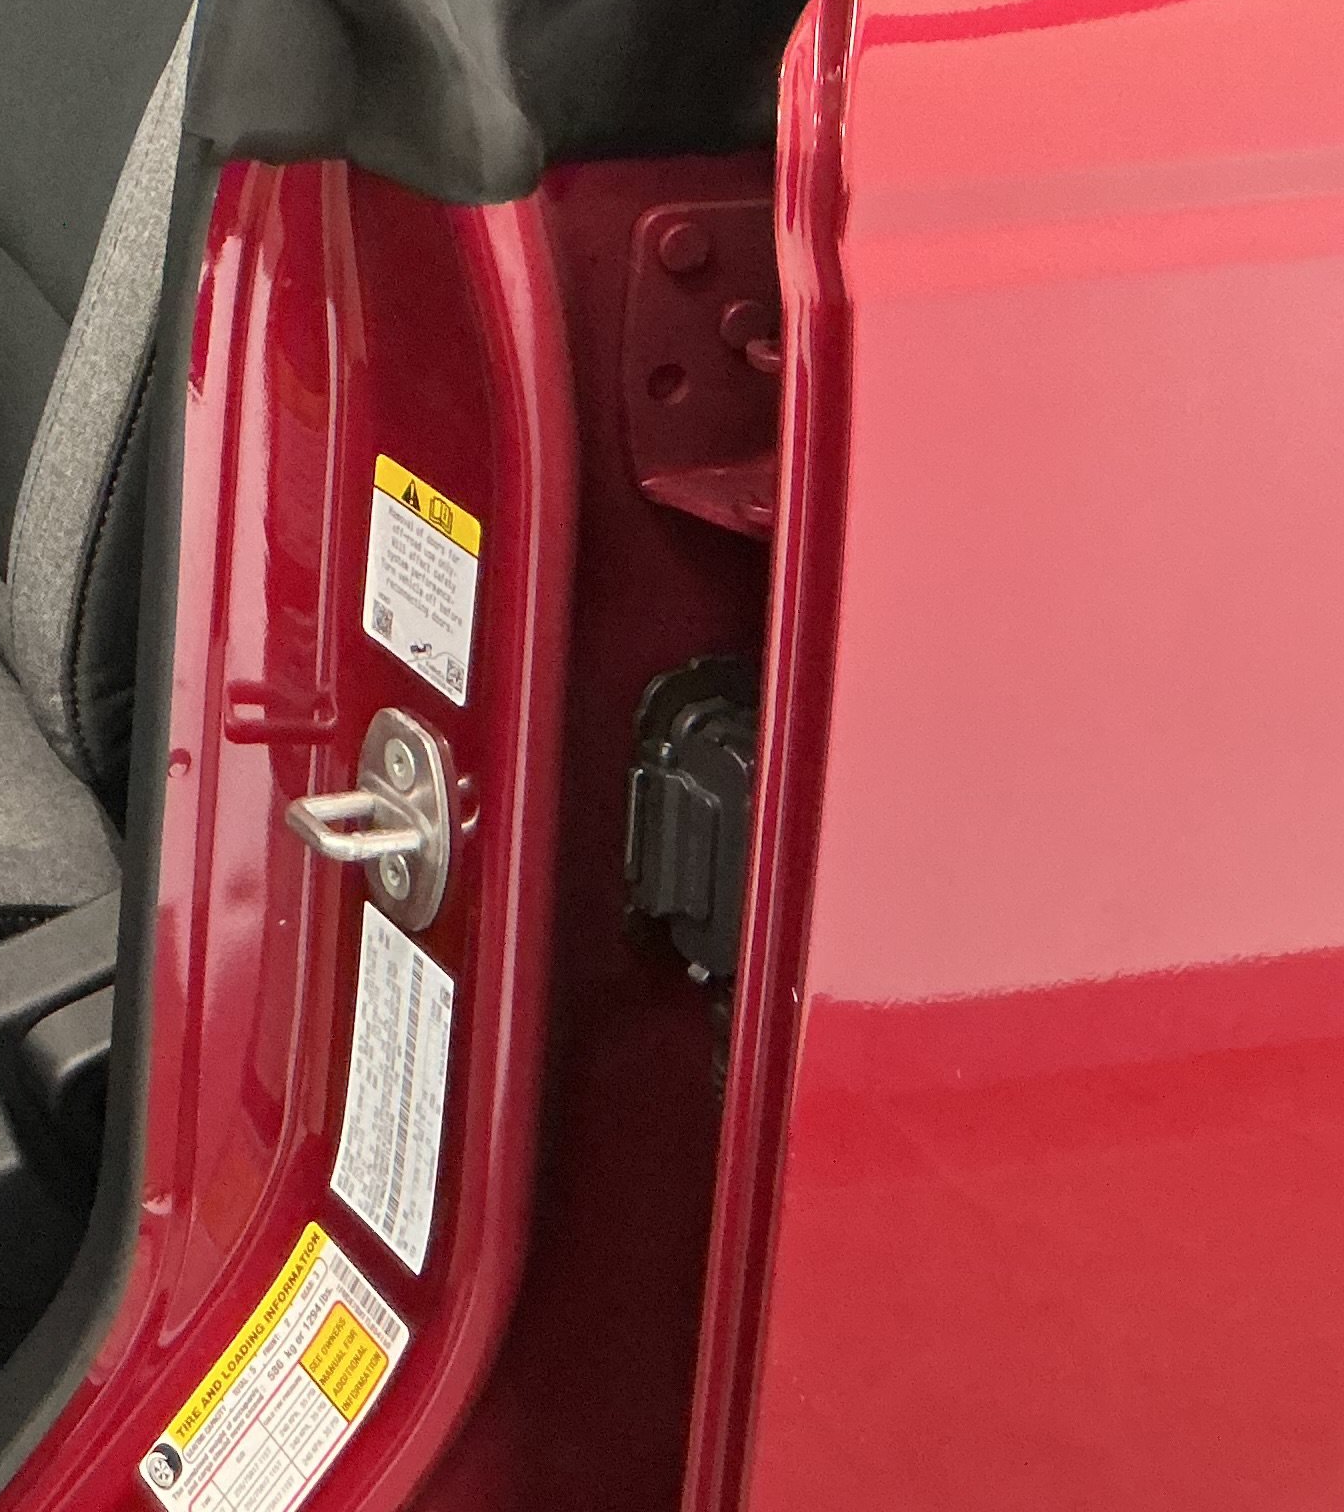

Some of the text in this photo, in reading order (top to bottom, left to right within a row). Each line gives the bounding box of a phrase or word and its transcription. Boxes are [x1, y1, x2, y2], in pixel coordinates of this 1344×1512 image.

[176, 1231, 320, 1438] TIRE AND LOADING INFORMATION
[282, 1342, 298, 1360] kg
[294, 1329, 306, 1345] or
[302, 1302, 322, 1331] 1294
[318, 1284, 334, 1306] lbs.
